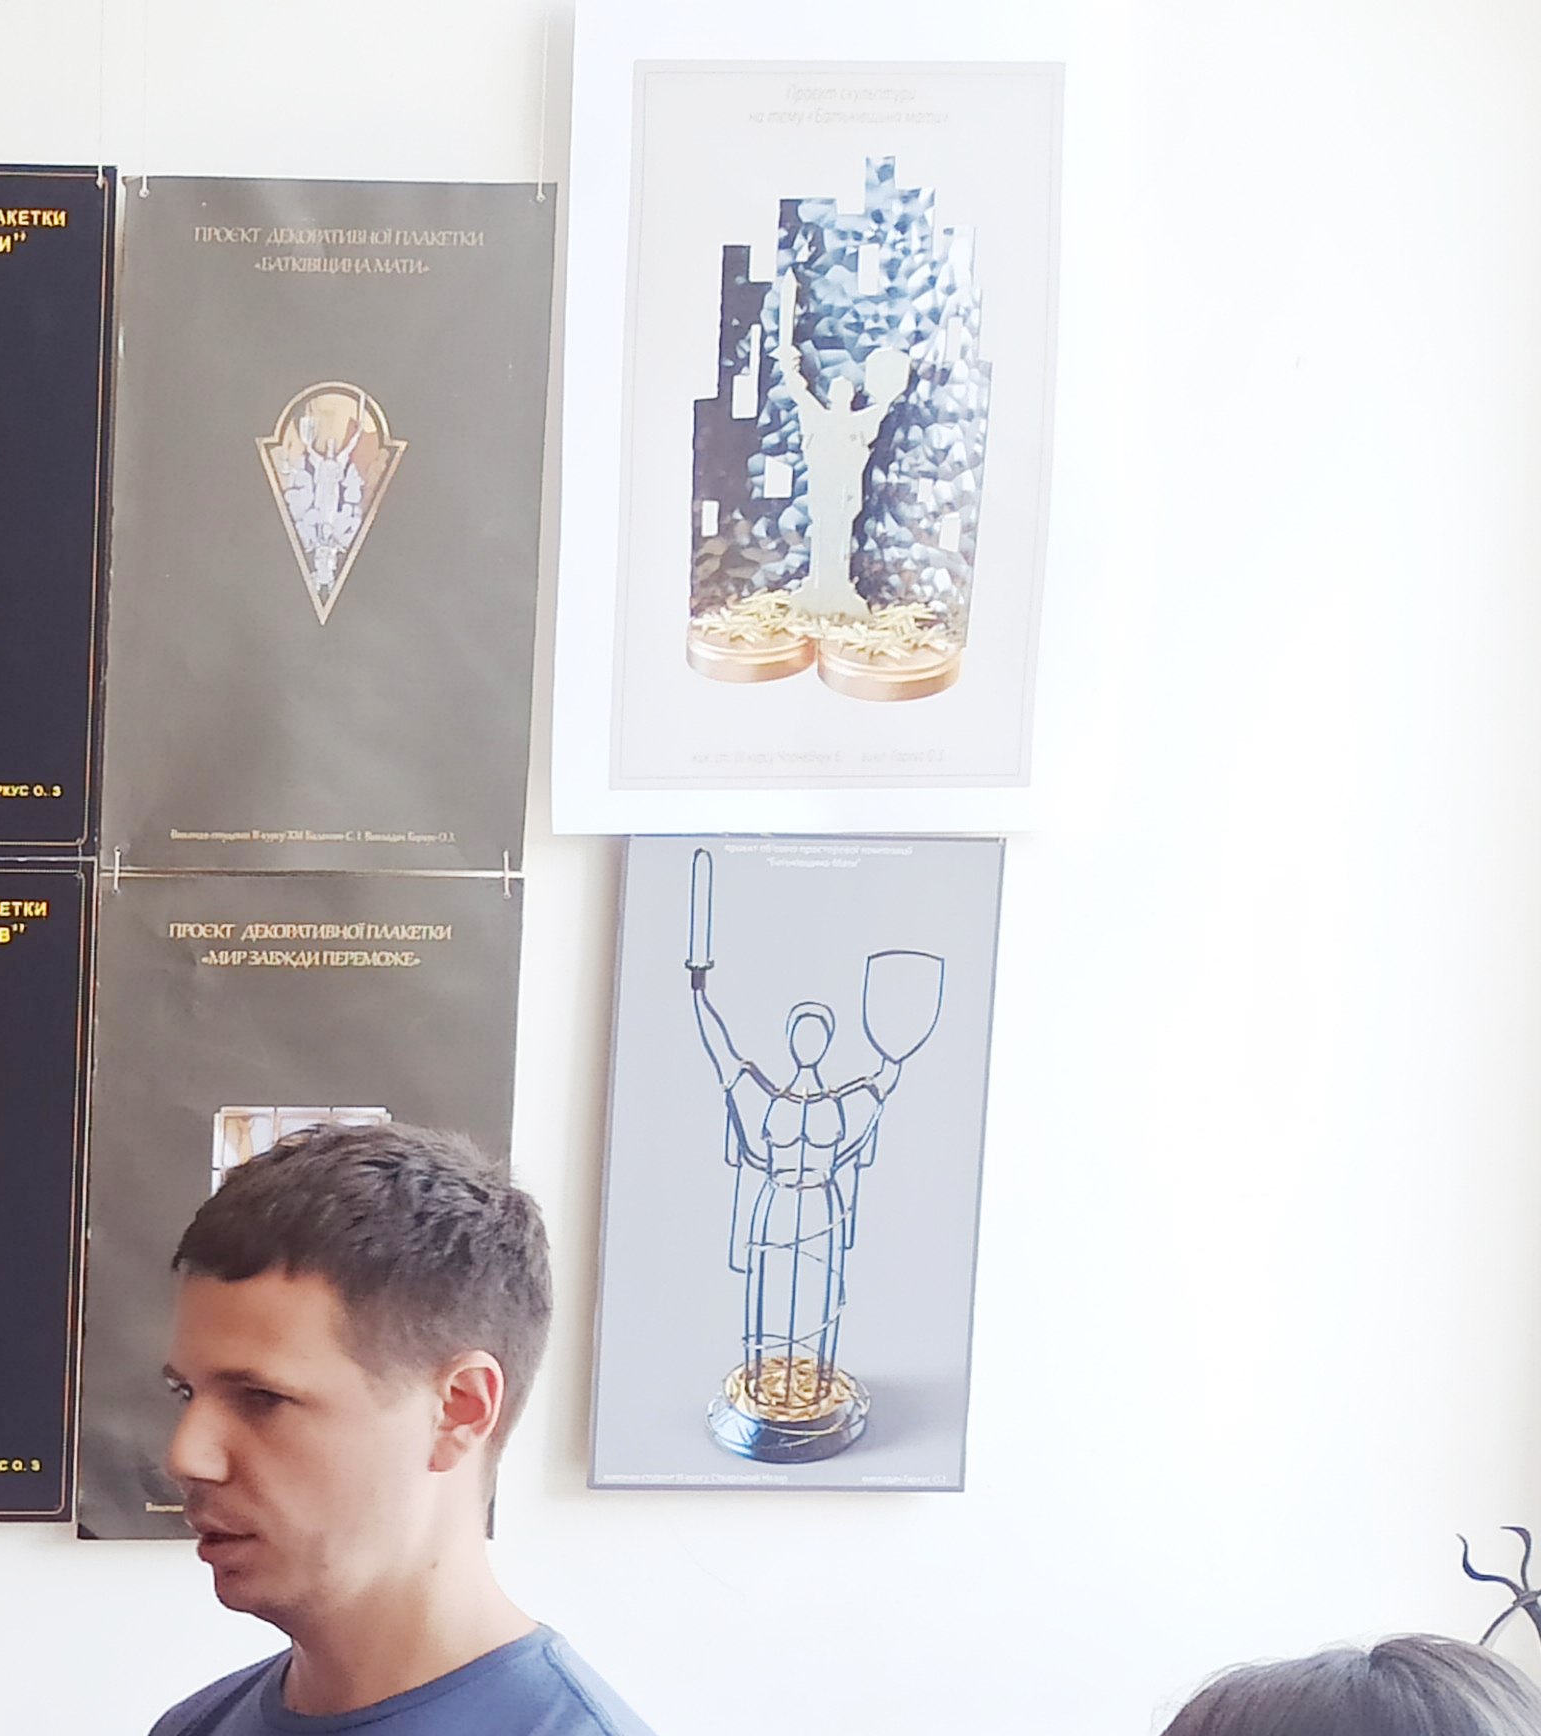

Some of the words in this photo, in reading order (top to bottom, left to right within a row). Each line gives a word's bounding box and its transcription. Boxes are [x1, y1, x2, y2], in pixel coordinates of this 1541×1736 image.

[265, 226, 391, 247] ДЕКОРАТИВНОЇ
[394, 228, 484, 247] ПЛАКЕТКИ
[240, 923, 366, 943] ДЕКОРАТИВНОЇ
[366, 925, 453, 942] ПЛАКЕТКИ
[248, 951, 321, 968] ЗАВЖДИ
